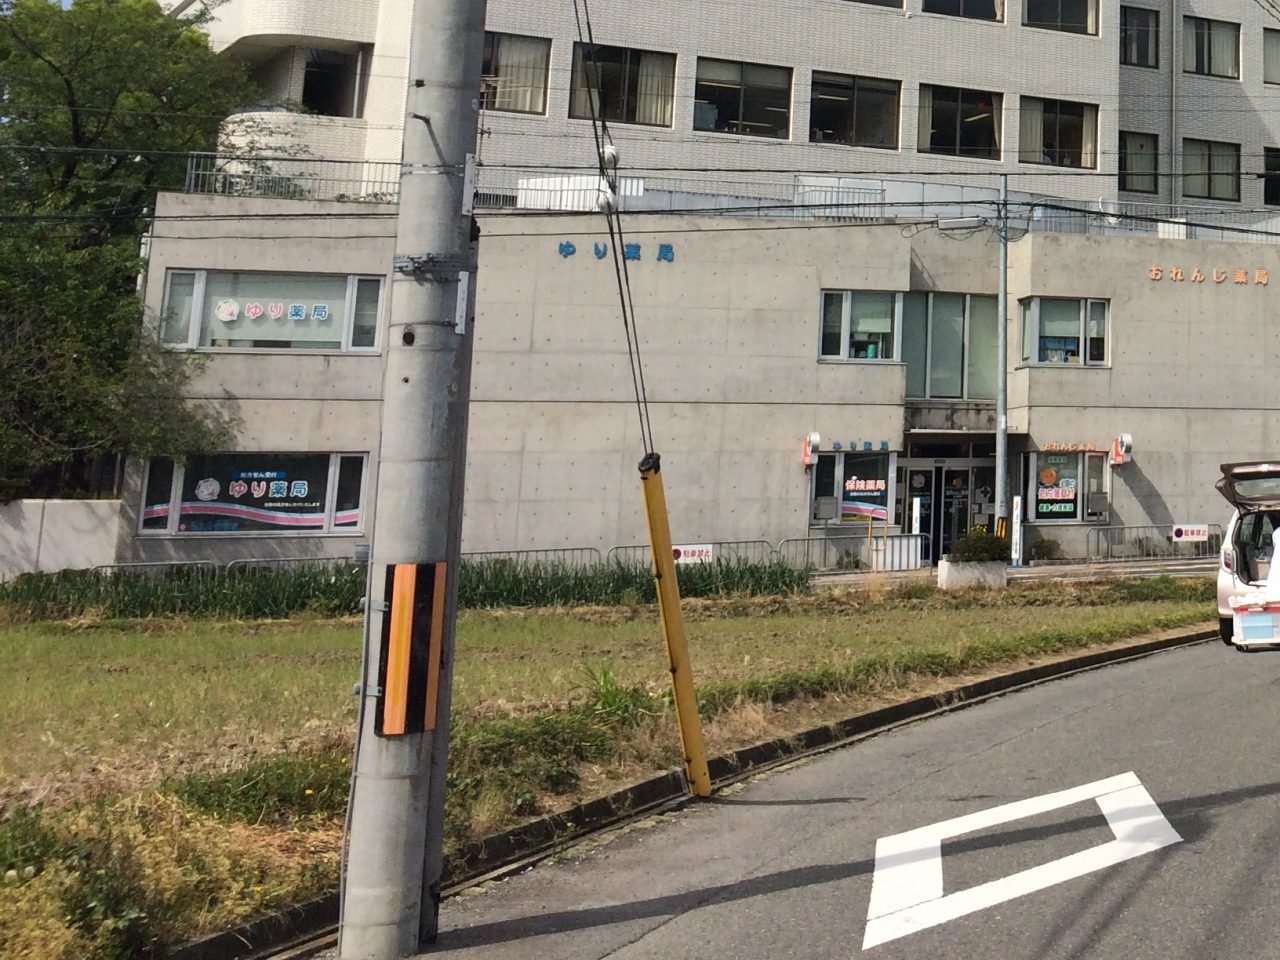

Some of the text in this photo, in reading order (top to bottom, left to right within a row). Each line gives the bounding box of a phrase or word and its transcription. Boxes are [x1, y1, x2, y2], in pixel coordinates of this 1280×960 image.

[558, 240, 675, 262] ゆり薬局
[1149, 265, 1270, 285] おれんじ薬局
[244, 302, 330, 320] ゆり薬局
[228, 480, 309, 499] ゆり薬局
